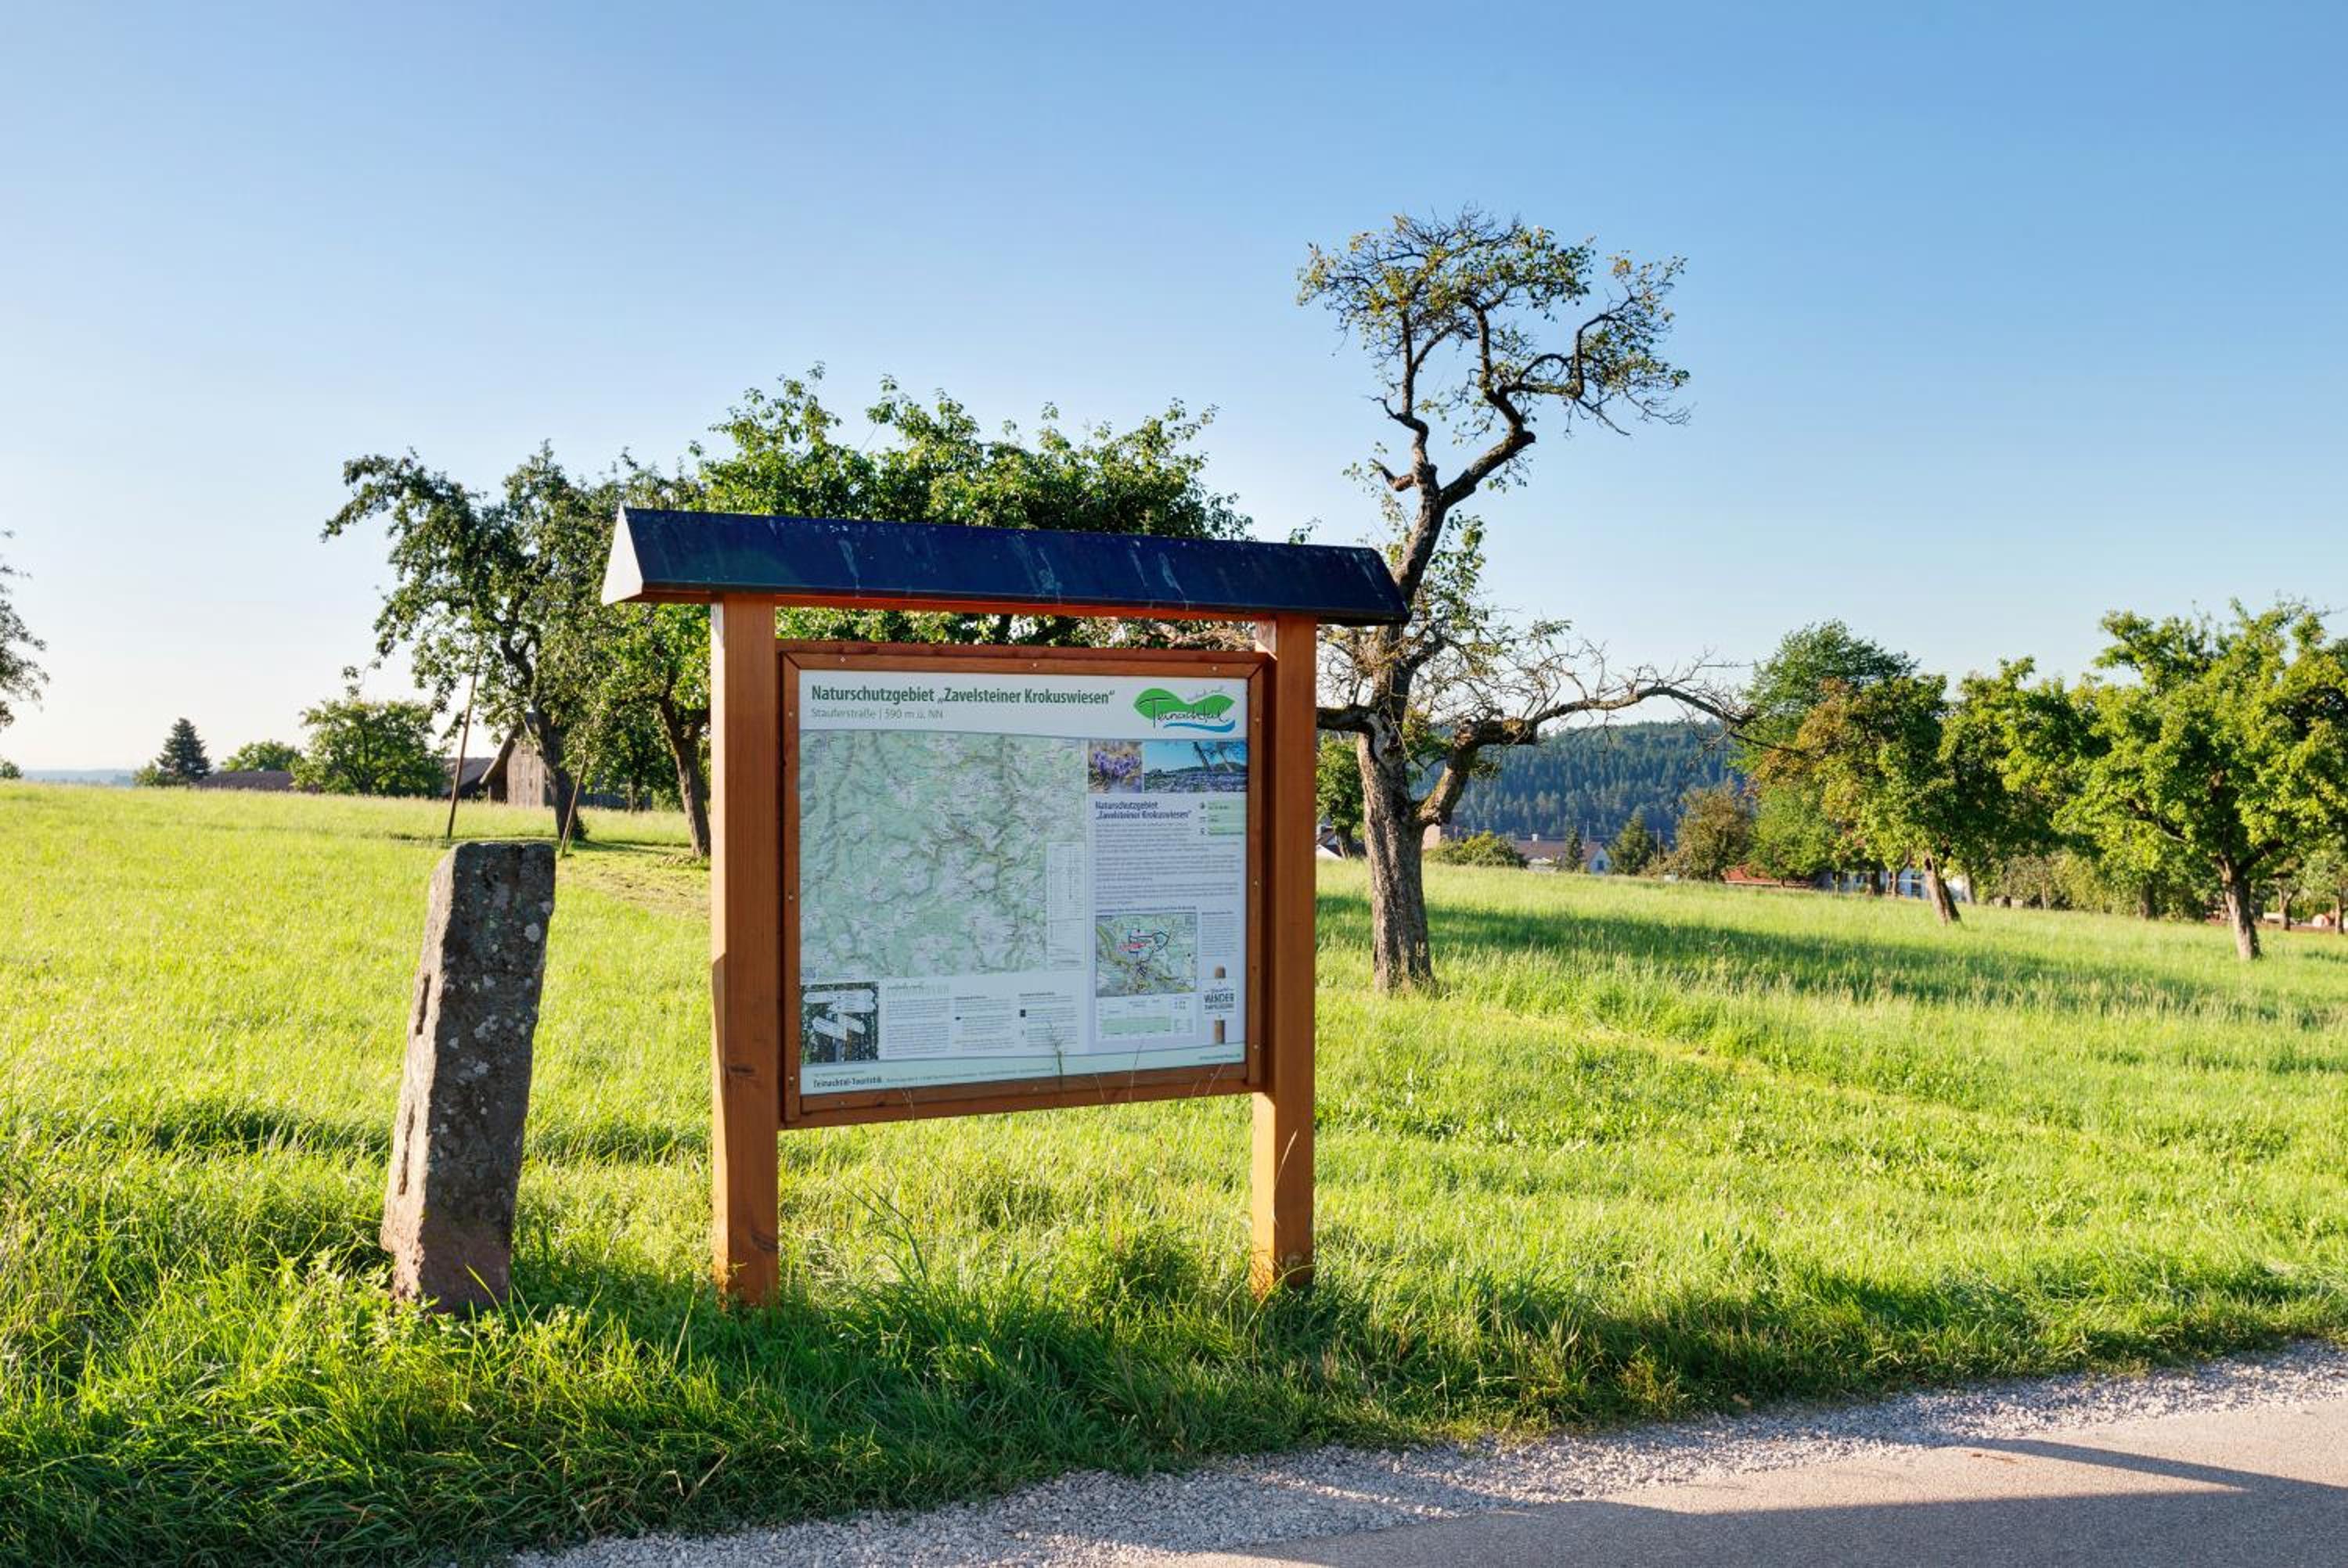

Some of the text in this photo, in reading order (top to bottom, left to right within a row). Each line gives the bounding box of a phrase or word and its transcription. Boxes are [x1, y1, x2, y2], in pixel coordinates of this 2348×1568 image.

[812, 685, 1115, 705] Naturschutzgebiet „Zavelsteiner Krokuswiesen“
[884, 708, 902, 718] 590
